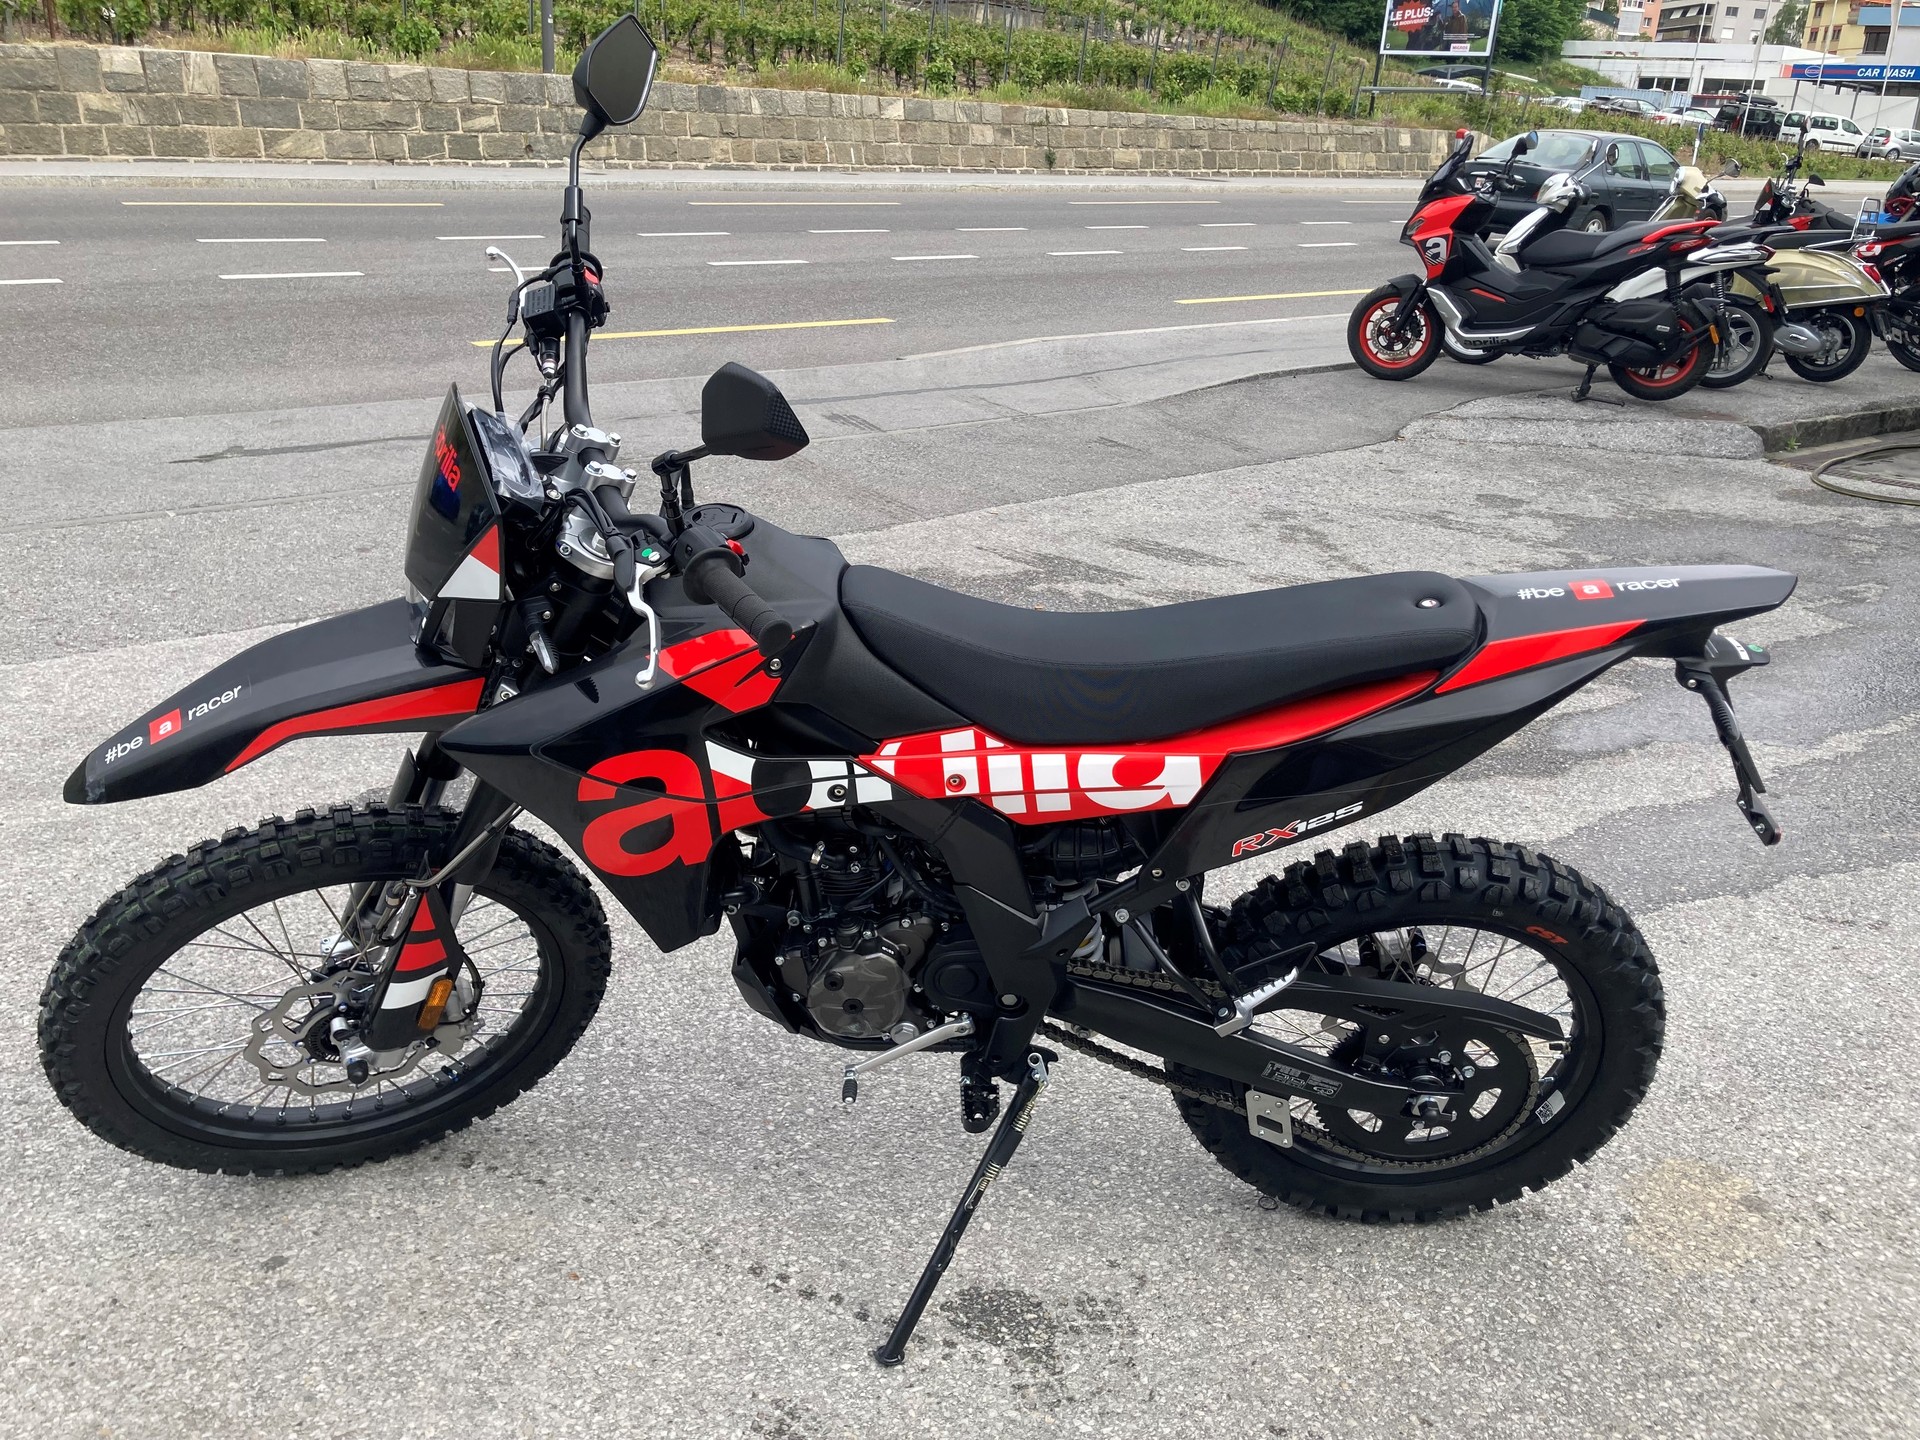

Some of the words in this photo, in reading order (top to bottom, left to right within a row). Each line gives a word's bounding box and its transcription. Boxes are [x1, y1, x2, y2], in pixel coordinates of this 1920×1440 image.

[1390, 11, 1403, 21] LE
[1404, 6, 1434, 20] PLUS:
[1857, 68, 1880, 77] CAR
[1882, 68, 1915, 77] WASH
[1463, 336, 1510, 348] aprilia
[1517, 587, 1565, 600] #be
[1616, 577, 1681, 592] racer
[104, 736, 143, 764] #be
[187, 685, 242, 721] racer
